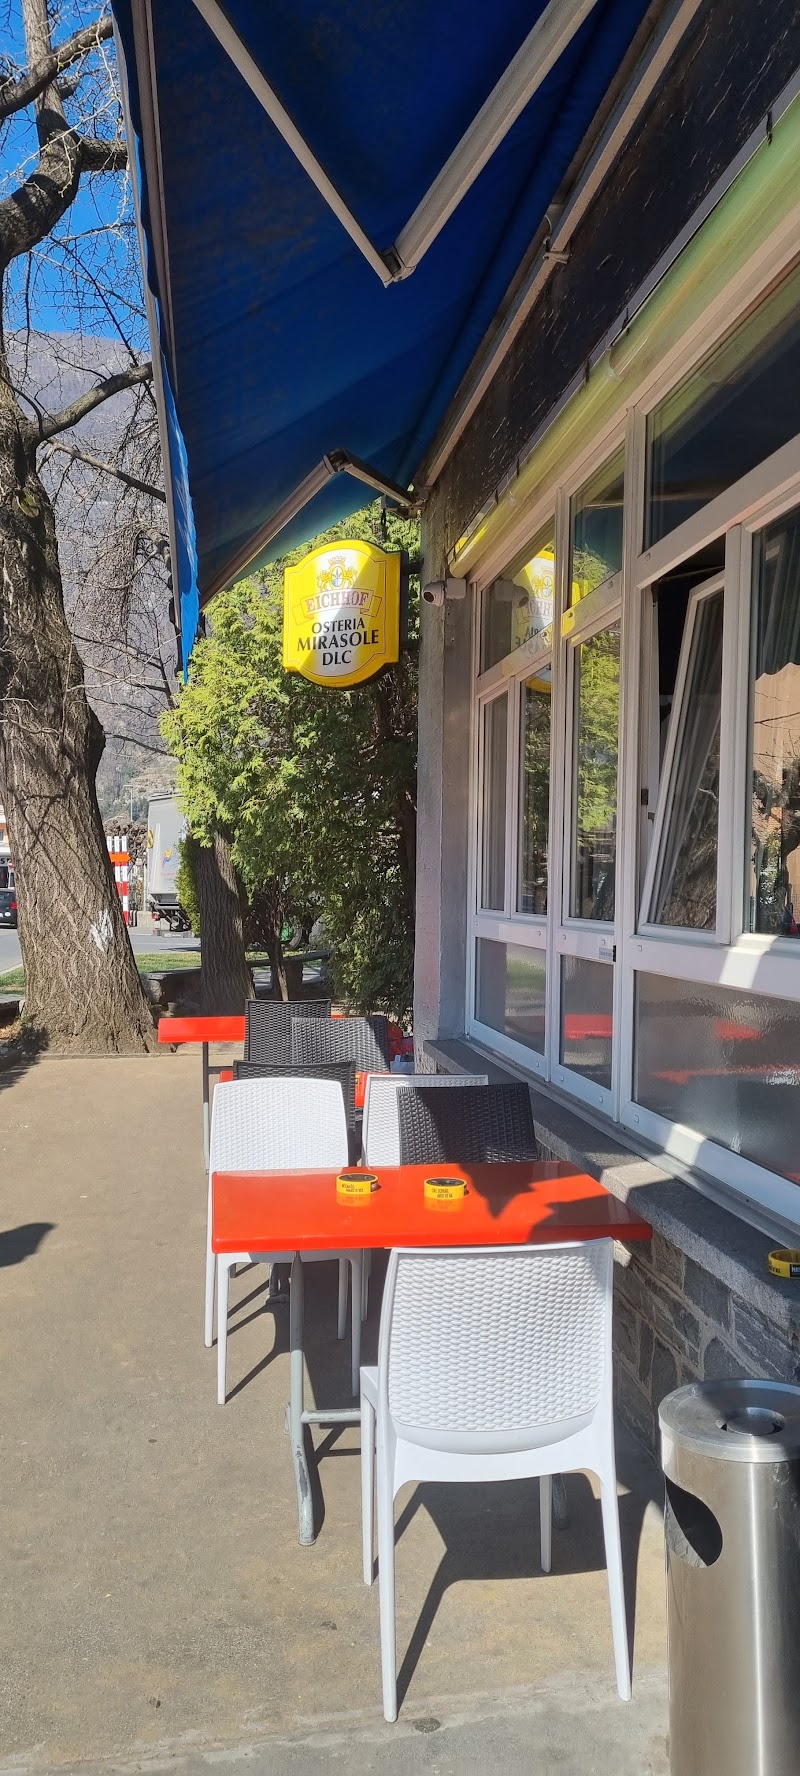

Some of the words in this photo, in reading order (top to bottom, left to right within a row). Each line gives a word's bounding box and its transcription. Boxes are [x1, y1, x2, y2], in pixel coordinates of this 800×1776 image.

[305, 591, 369, 613] EICHHOF
[311, 617, 366, 634] OSTERIA
[297, 629, 380, 652] MIRASOLE
[322, 649, 352, 666] DLC
